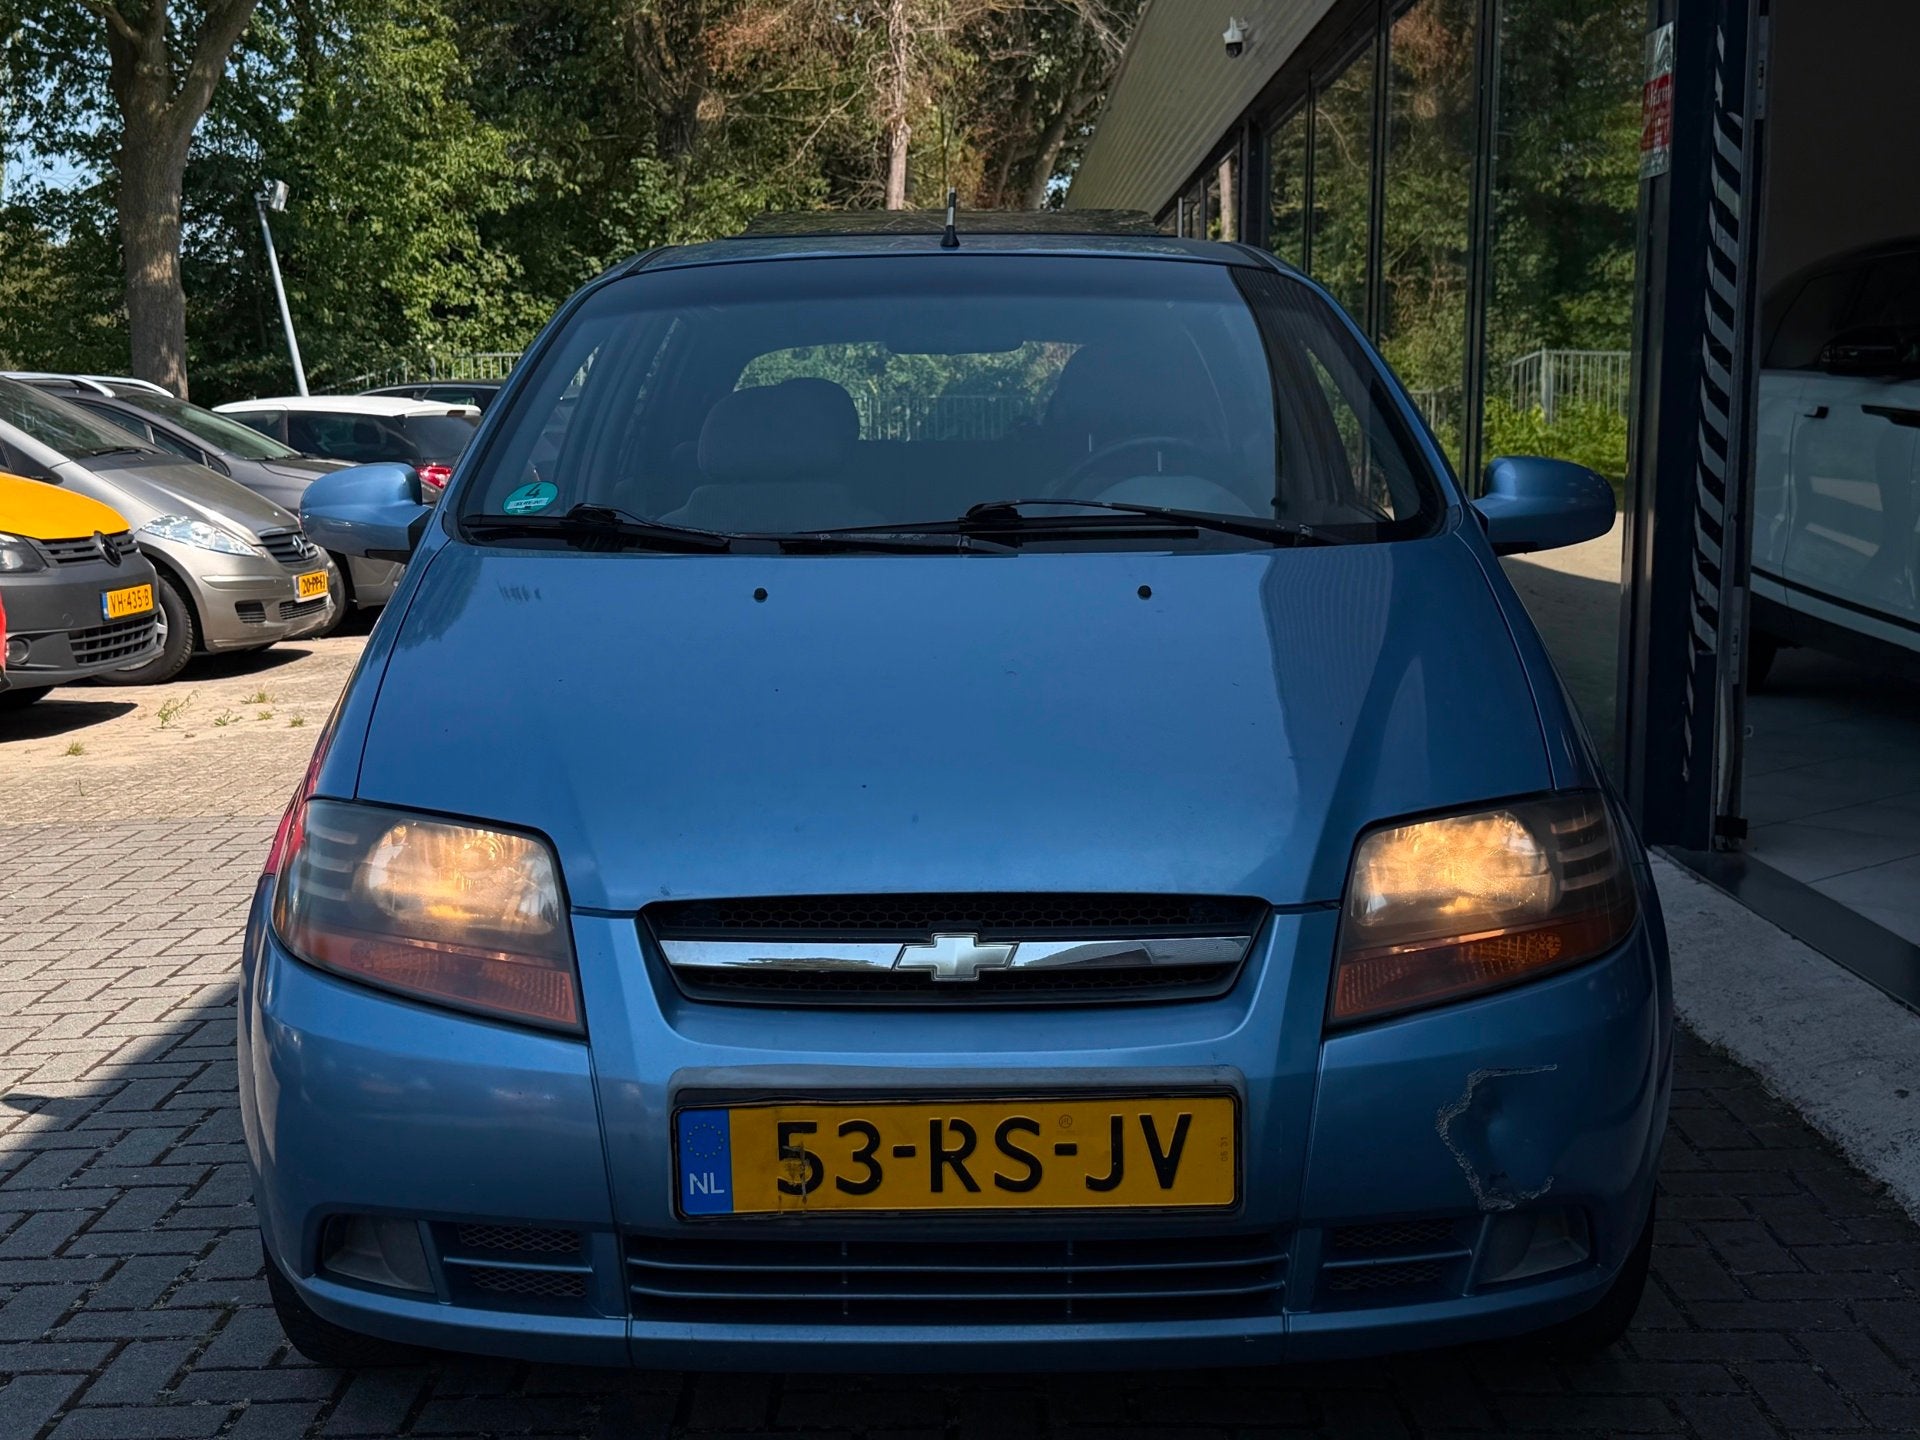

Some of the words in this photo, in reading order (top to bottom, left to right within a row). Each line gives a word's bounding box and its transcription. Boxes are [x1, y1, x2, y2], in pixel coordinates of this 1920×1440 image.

[525, 483, 541, 498] 4
[110, 588, 150, 613] VH-435-B
[777, 1113, 1194, 1196] 53-RS-JV
[689, 1172, 726, 1196] NL
